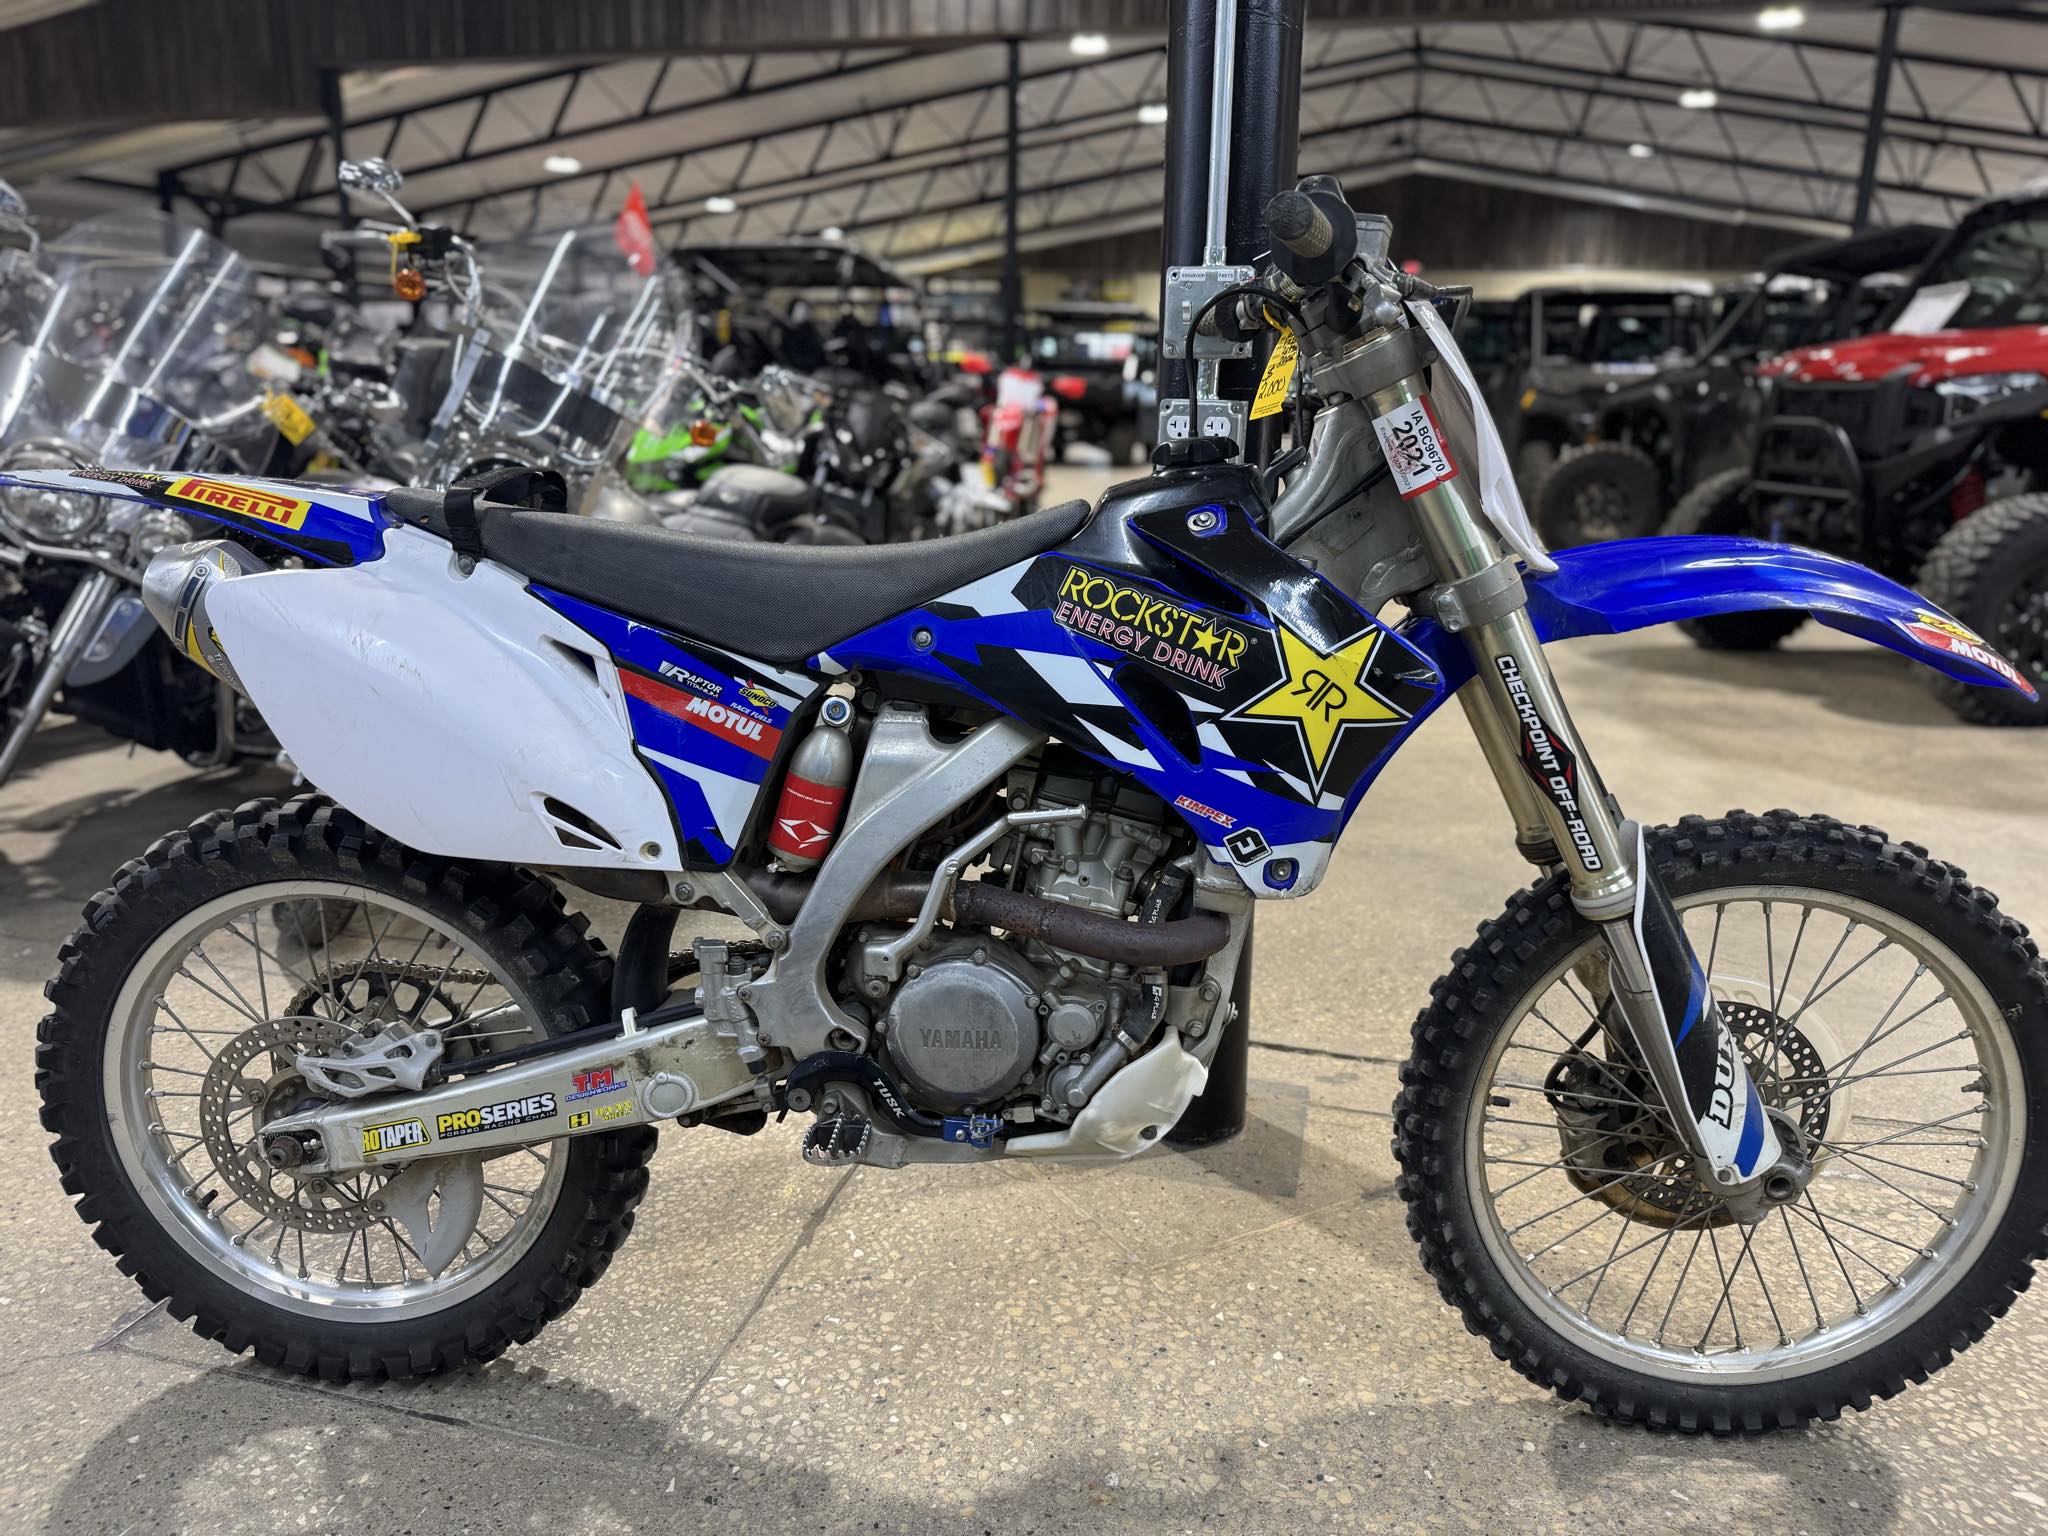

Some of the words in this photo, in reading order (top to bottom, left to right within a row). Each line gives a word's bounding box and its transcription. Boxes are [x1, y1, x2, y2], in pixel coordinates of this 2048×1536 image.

[1391, 420, 1432, 477] 2021
[1410, 409, 1424, 426] IA
[1418, 425, 1446, 472] BC9670
[118, 476, 155, 489] DRINK
[178, 478, 299, 525] PIRELLI
[1055, 601, 1150, 660] ENERGY
[1152, 641, 1230, 689] DRINK
[1951, 638, 2022, 686] MOTUL
[730, 702, 752, 715] RACE
[751, 711, 774, 724] FUELS
[738, 687, 779, 709] SUNOCO
[685, 696, 764, 742] MOTUL
[1498, 655, 1560, 773] CHECKPOINT
[1549, 775, 1601, 871] OFF-ROAD
[1174, 795, 1237, 828] KIMPEX
[919, 1028, 1002, 1051] YAMAHA
[565, 1080, 627, 1102] DESIGNWORKS
[572, 1065, 614, 1093] TM
[873, 1078, 905, 1118] TUSK
[440, 1127, 480, 1139] FORGED
[484, 1119, 521, 1131] RACING
[525, 1110, 557, 1121] CHAIN
